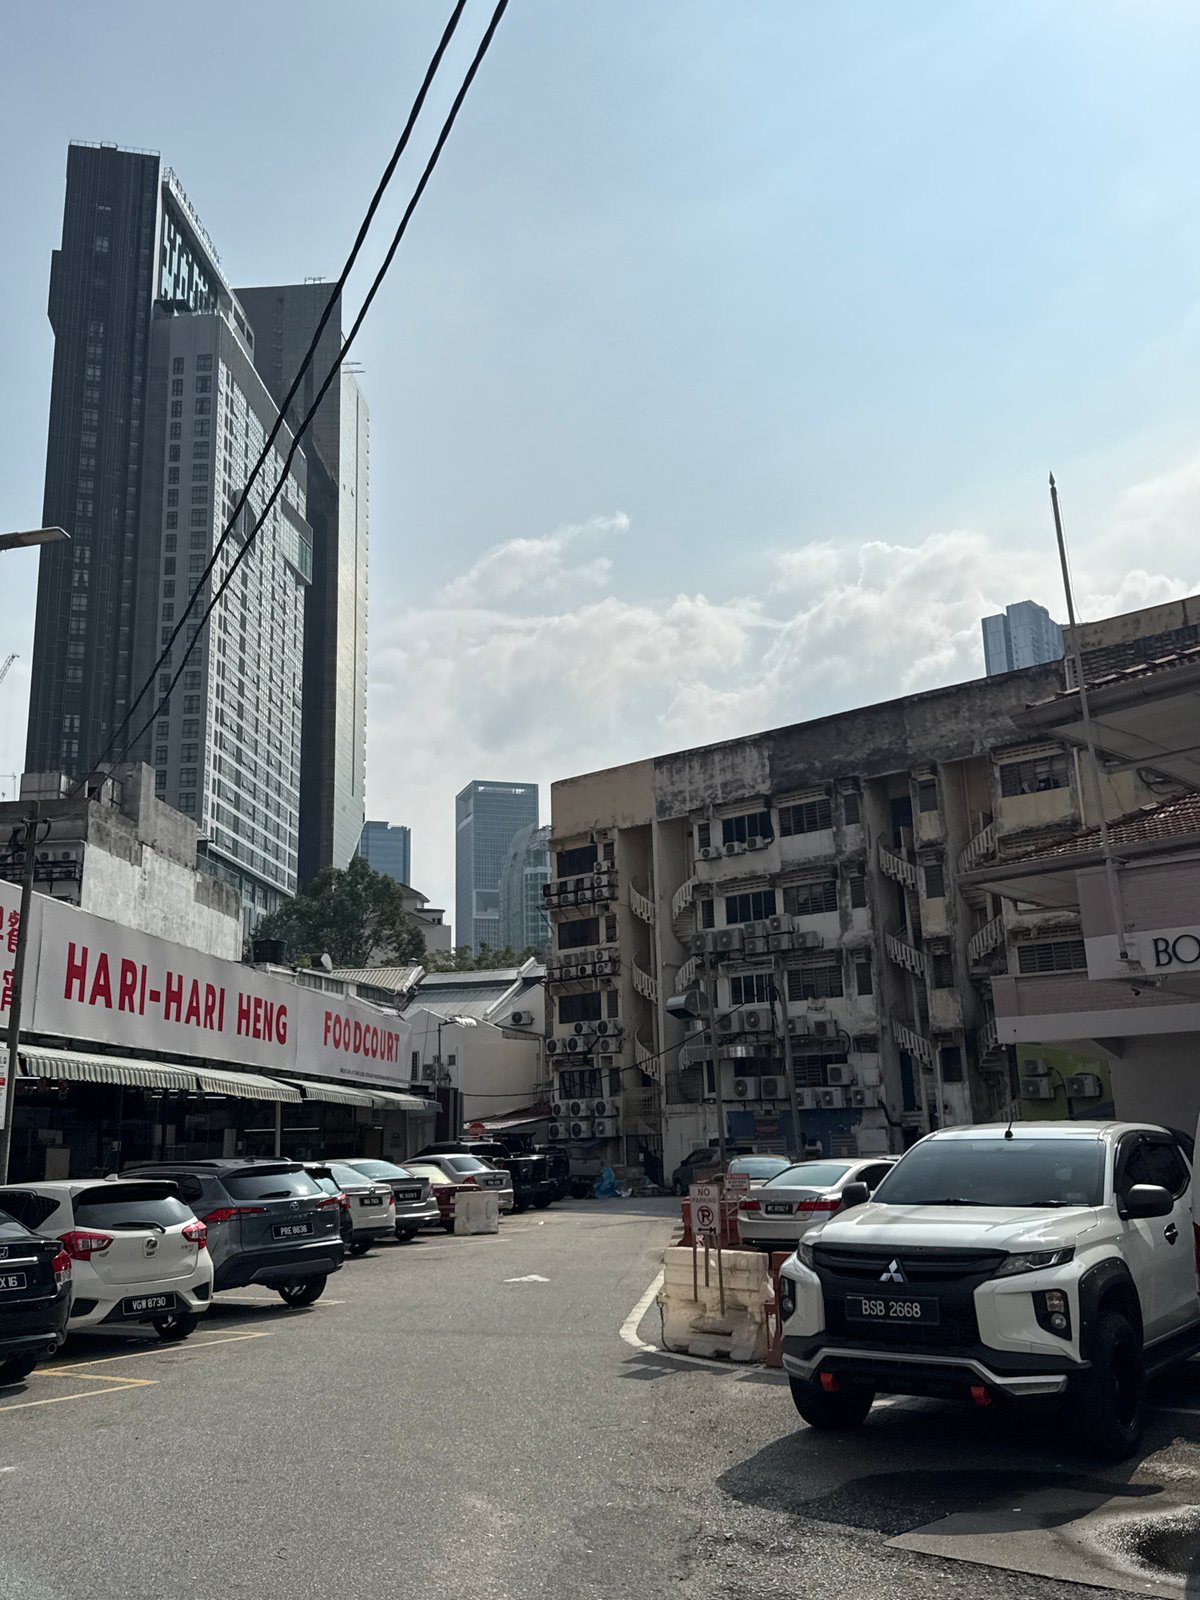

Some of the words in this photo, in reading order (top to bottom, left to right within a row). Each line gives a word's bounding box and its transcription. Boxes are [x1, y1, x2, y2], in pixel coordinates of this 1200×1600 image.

[1152, 934, 1200, 968] BO
[64, 943, 225, 1032] HARI-HARI
[237, 992, 288, 1045] HENG
[323, 1011, 400, 1063] FOODCOURT
[697, 1187, 711, 1197] NO
[280, 1226, 292, 1236] PRE
[7, 1276, 18, 1288] 16
[132, 1300, 147, 1310] VGW
[147, 1296, 166, 1308] 8730
[861, 1299, 886, 1316] BSB
[888, 1301, 921, 1318] 2668
